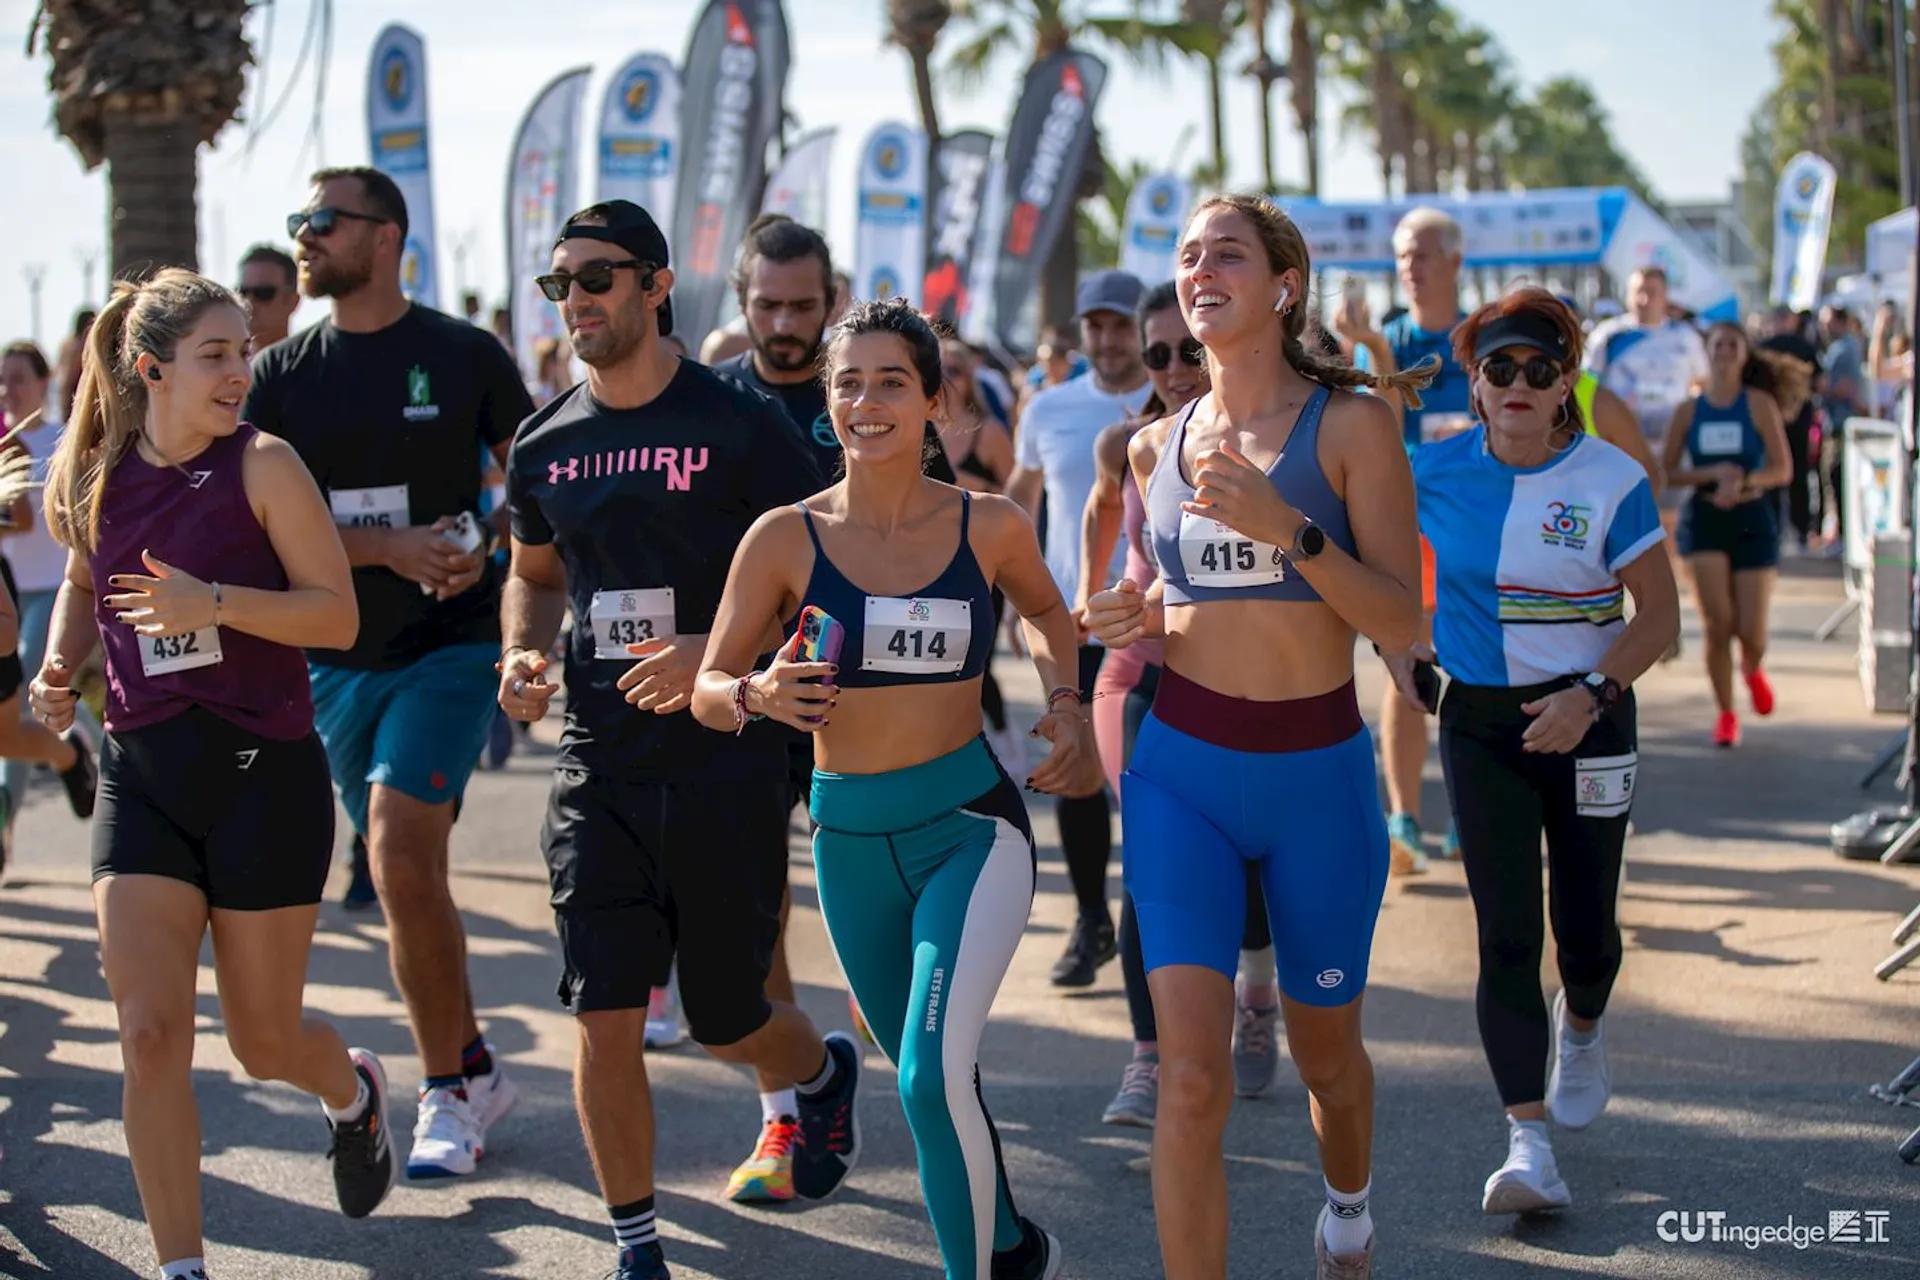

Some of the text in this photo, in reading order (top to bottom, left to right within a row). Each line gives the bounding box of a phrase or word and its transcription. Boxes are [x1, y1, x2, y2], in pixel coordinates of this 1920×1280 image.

[1542, 501, 1591, 537] 365
[1201, 541, 1255, 571] 415
[154, 631, 199, 659] 432
[609, 619, 654, 645] 433
[888, 629, 946, 659] 414
[925, 993, 940, 1032] FRANS
